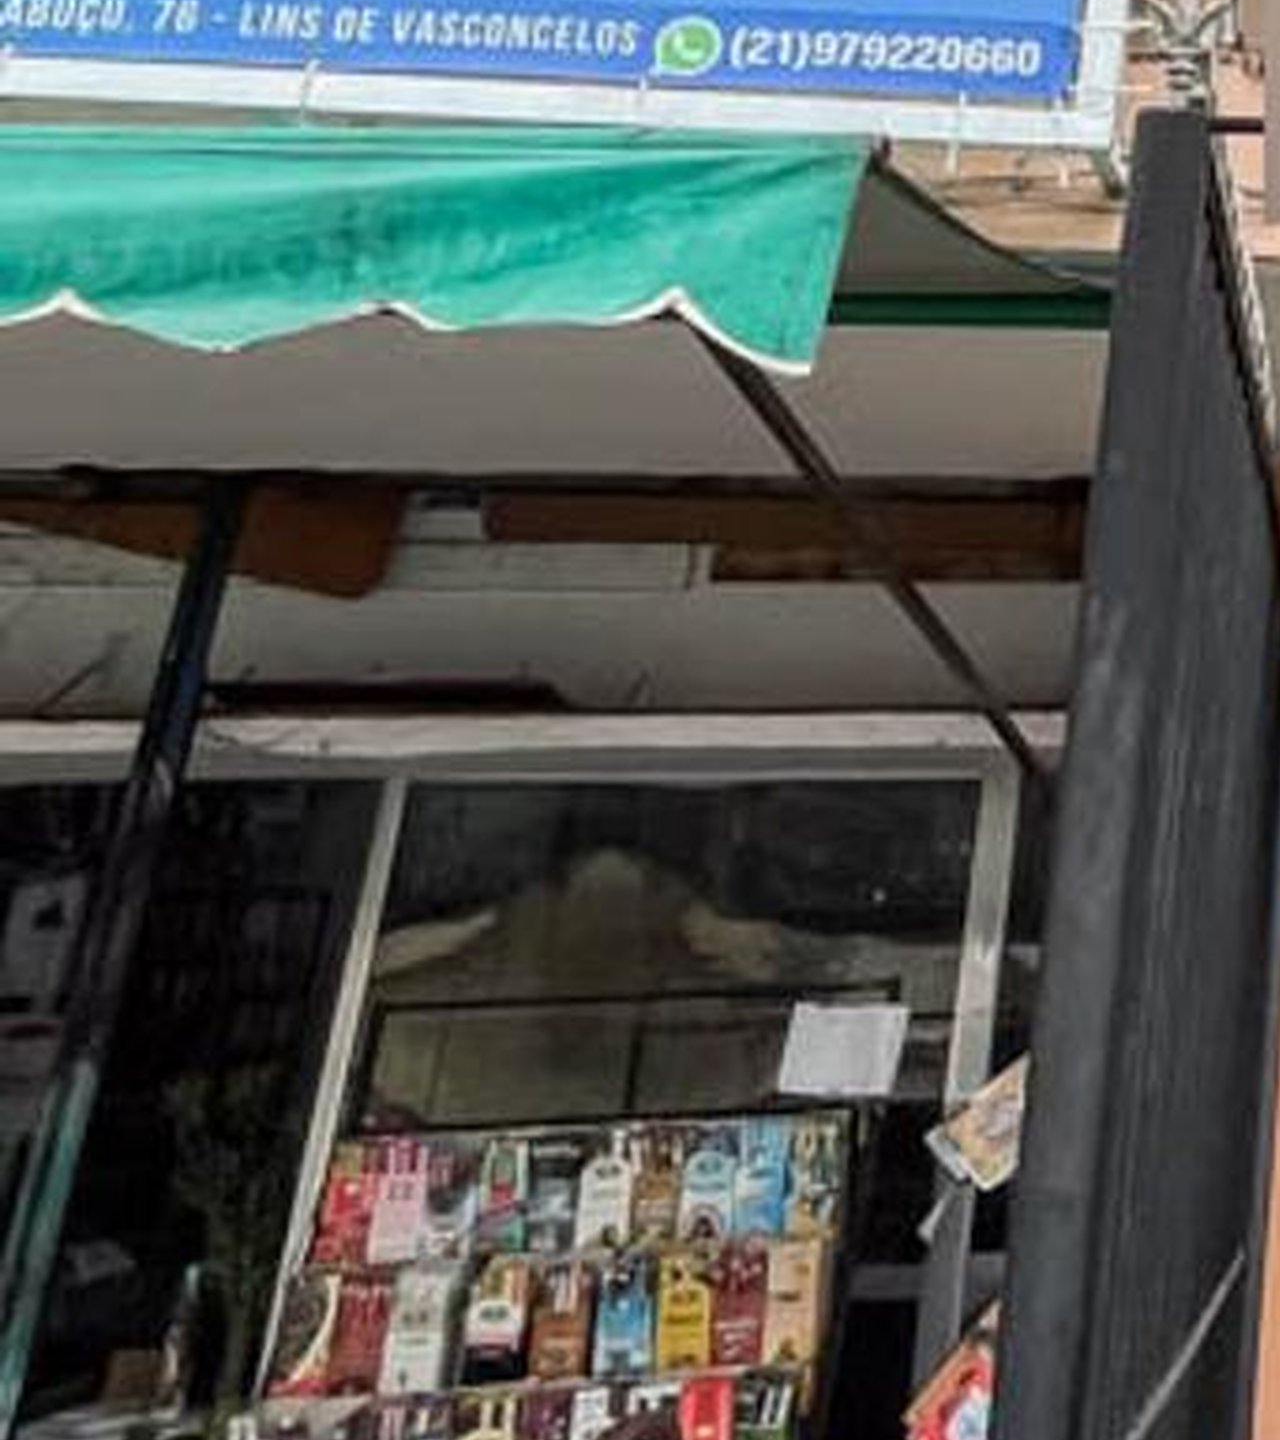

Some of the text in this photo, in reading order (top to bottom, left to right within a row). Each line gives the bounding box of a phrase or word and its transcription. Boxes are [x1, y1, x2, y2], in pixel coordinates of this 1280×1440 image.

[240, 0, 324, 40] LINS
[334, 8, 380, 43] DE
[393, 10, 640, 57] VASCONCELOS
[729, 29, 1042, 78] (21)979220660
